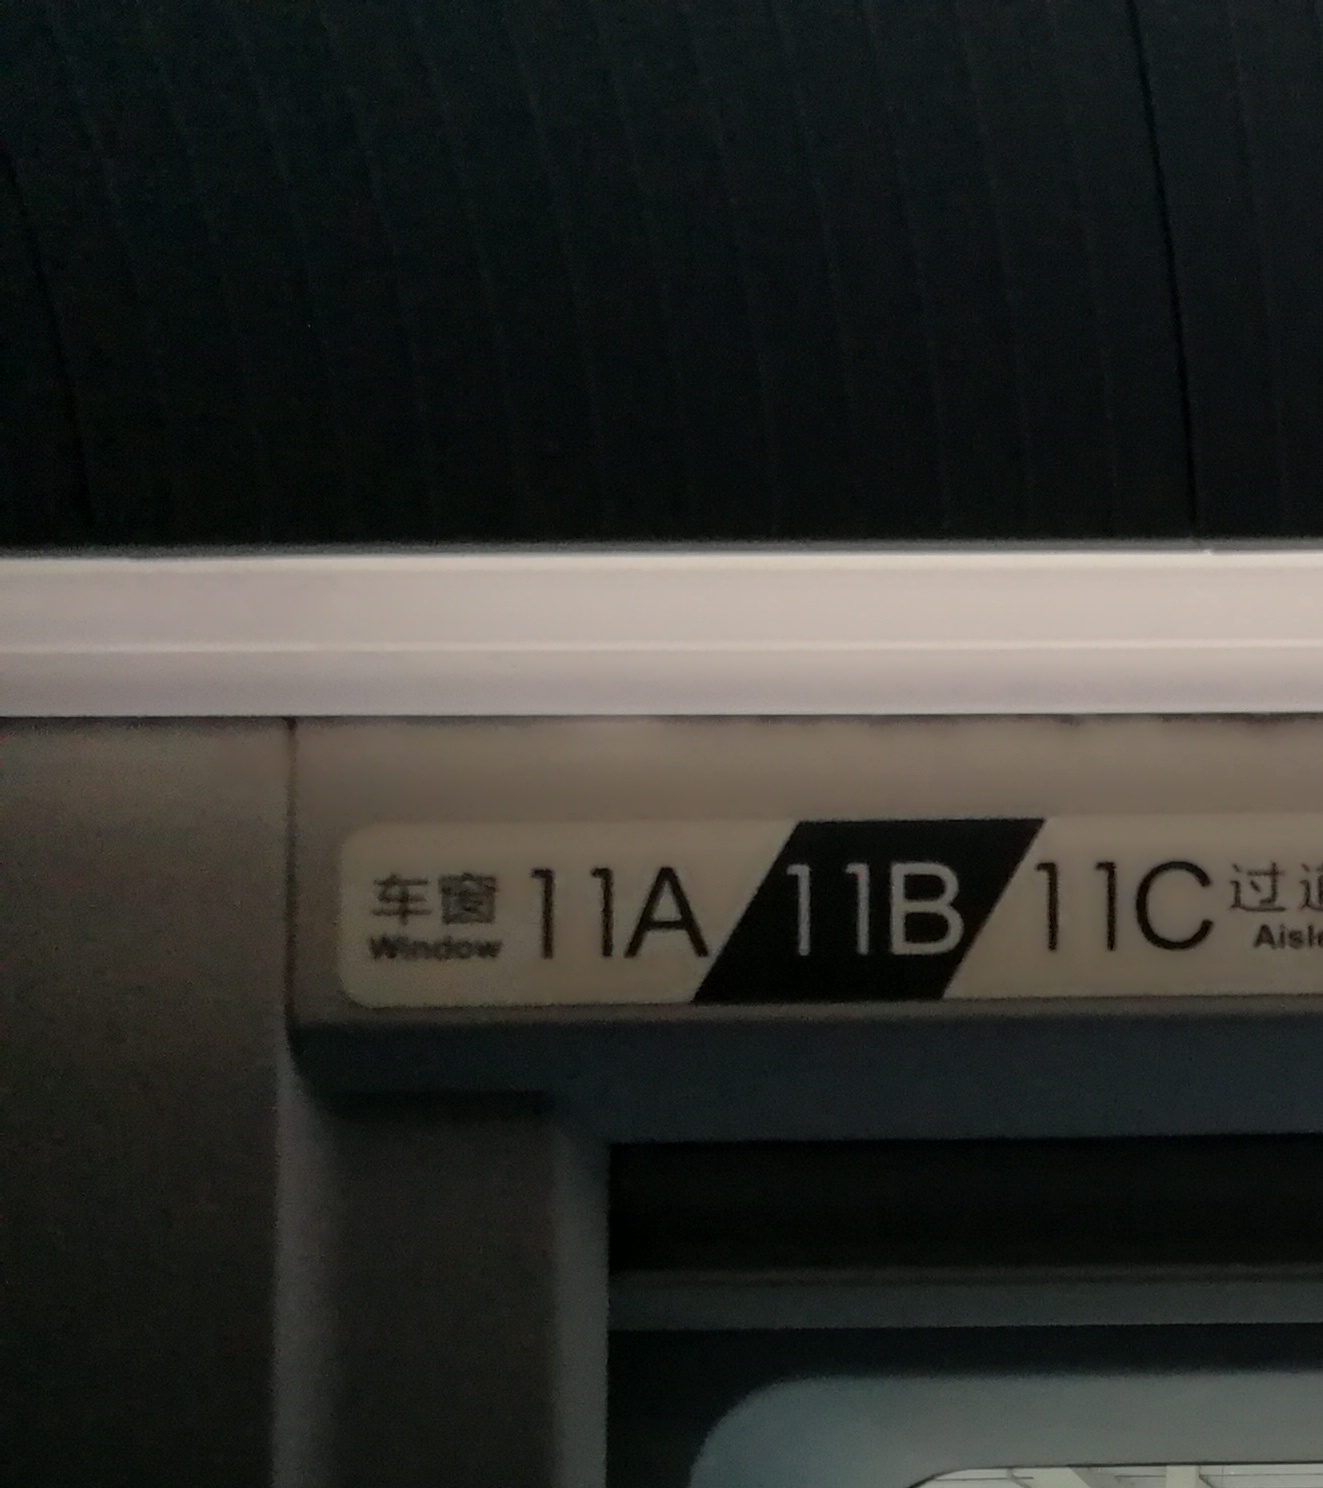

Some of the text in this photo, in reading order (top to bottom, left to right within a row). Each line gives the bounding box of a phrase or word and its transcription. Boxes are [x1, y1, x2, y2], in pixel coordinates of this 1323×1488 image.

[371, 872, 498, 925] 车窗
[530, 867, 709, 959] 11A
[786, 860, 965, 957] 11B
[1035, 860, 1214, 952] 11C
[369, 933, 502, 962] Window
